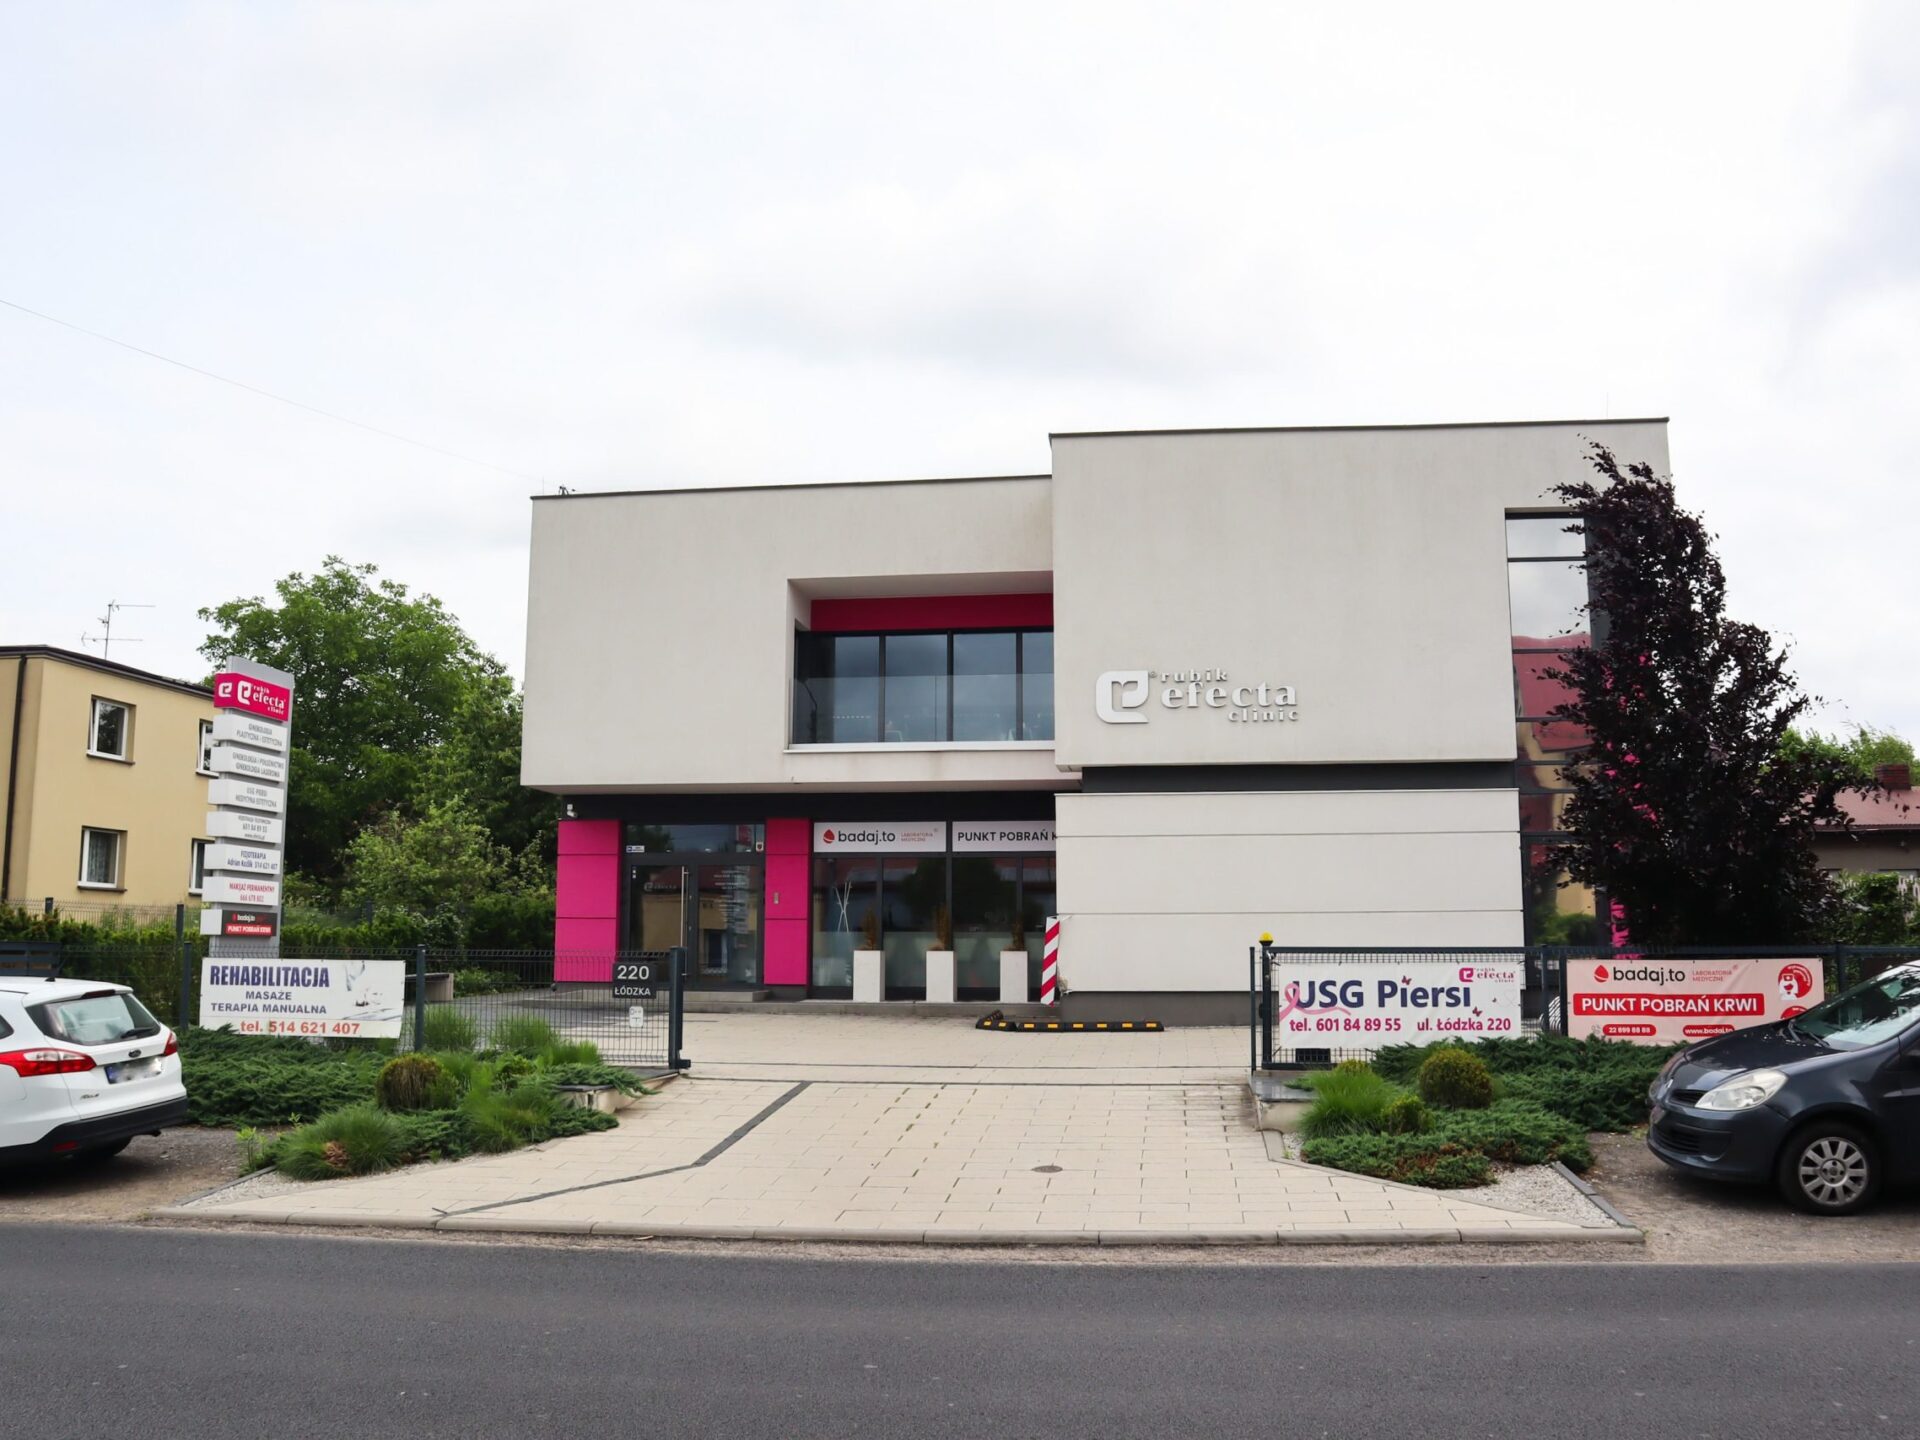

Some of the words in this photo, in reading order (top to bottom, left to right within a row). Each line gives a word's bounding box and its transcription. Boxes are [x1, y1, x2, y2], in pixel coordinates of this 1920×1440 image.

[1161, 668, 1227, 682] rubik
[253, 692, 284, 709] efecta
[1161, 682, 1297, 708] efecta
[1228, 708, 1298, 722] clinic
[838, 830, 895, 845] badaj.to
[958, 832, 996, 841] PUNKT
[1000, 829, 1048, 841] POBRAŃ
[210, 965, 330, 988] REHABILITACJA
[617, 965, 650, 980] 220
[1613, 966, 1686, 986] badaj.to
[614, 985, 651, 995] ŁÓDZKA
[1293, 980, 1364, 1008] USG
[1378, 980, 1471, 1008] Piersi
[211, 1002, 259, 1013] TERAPIA
[262, 1003, 327, 1014] MANUALNA
[1582, 998, 1636, 1012] PUNKT
[1641, 995, 1710, 1012] POBRAŃ
[1714, 998, 1757, 1012] KRWI
[240, 1021, 263, 1032] tel.
[268, 1021, 295, 1033] 514
[300, 1022, 326, 1034] 621
[332, 1022, 360, 1035] 407
[1289, 1018, 1312, 1032] tel.
[1316, 1019, 1340, 1031] 601
[1344, 1019, 1361, 1031] 84
[1364, 1019, 1381, 1031] 89
[1385, 1019, 1401, 1031] 55
[1417, 1018, 1433, 1031] ul.
[1437, 1018, 1483, 1031] Łódzka
[1487, 1018, 1511, 1031] 220
